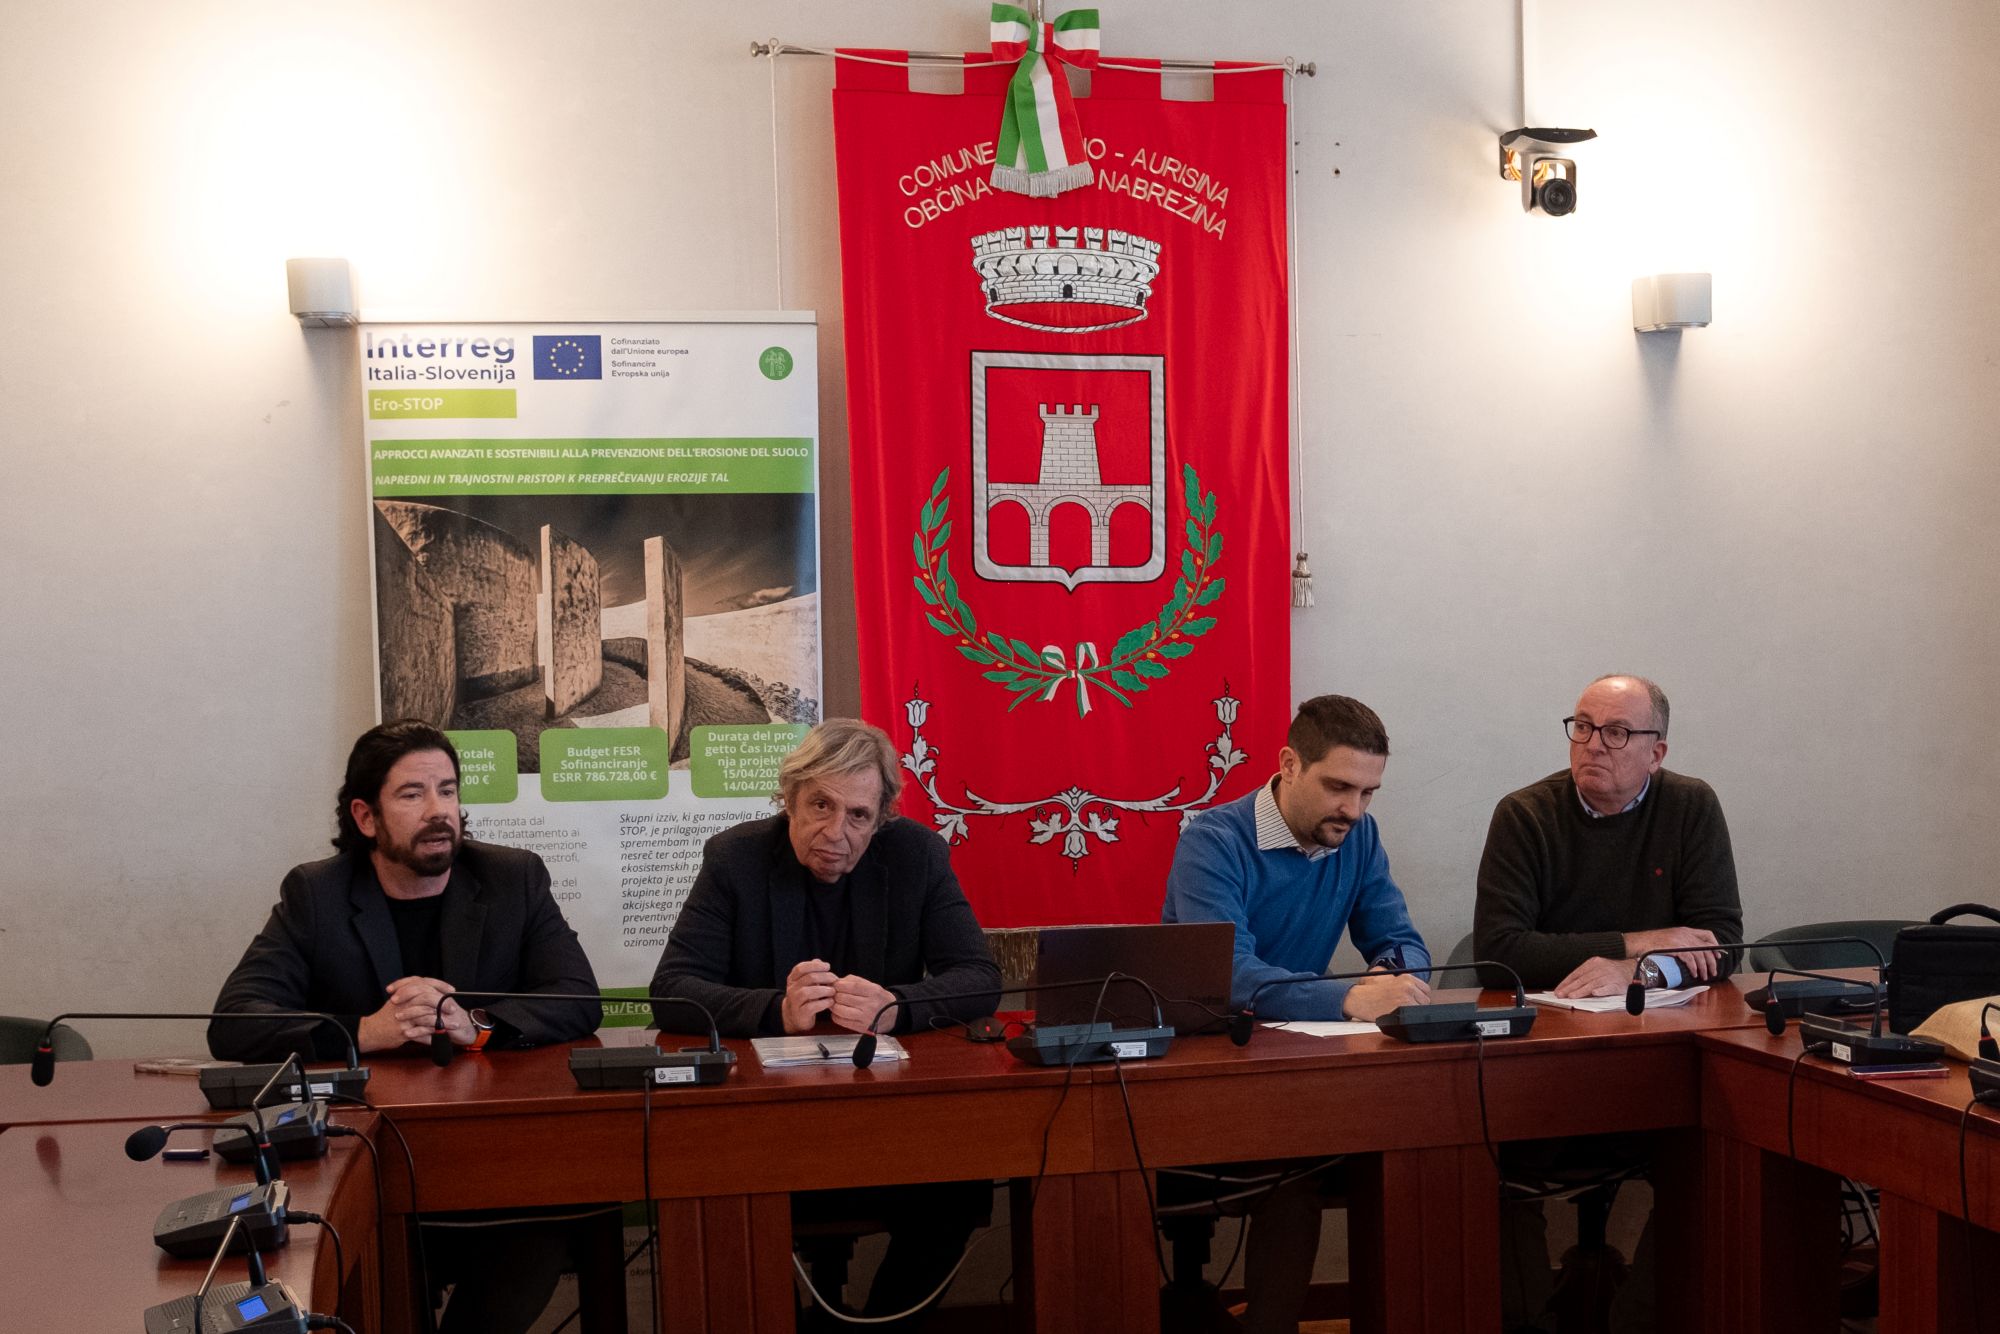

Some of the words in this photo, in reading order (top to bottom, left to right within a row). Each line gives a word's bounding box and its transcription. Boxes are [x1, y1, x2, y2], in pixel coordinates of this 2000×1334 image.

[899, 142, 996, 196] COMUNE
[1131, 148, 1229, 209] AURISINA
[904, 176, 993, 228] OBČINA
[1098, 169, 1227, 240] NABREŽINA
[366, 332, 514, 363] Interreg
[610, 338, 660, 346] Cofinanziato
[611, 347, 655, 355] dall'Unione
[612, 360, 656, 368] Sofinancira
[369, 365, 515, 383] Italia-Slovenija
[612, 370, 648, 378] Evropska
[651, 370, 670, 378] unija
[374, 398, 444, 411] Ero-STOP
[374, 450, 428, 460] APPROCCI
[430, 450, 484, 459] AVANZATI
[487, 449, 492, 458] E
[495, 449, 559, 458] SOSTENIBILI
[562, 448, 589, 458] ALLA
[592, 448, 664, 458] PREVENZIONE
[667, 448, 748, 458] DELL'EROSIONE
[750, 448, 770, 457] DEL
[772, 448, 808, 457] SUOLO
[375, 475, 430, 485] NAPREDNI
[433, 475, 446, 484] IN
[449, 474, 514, 486] TRAJNOSTNI
[517, 474, 565, 484] PRISTOPI
[568, 474, 576, 483] K
[578, 472, 664, 485] PREPREČEVANJU
[667, 473, 708, 485] EROZIJE
[710, 473, 729, 483] TAL
[708, 732, 750, 742] Durata
[753, 731, 770, 740] del
[774, 732, 798, 743] pro-
[568, 747, 609, 759] Budget
[613, 746, 640, 756] FESR
[705, 744, 736, 757] getto
[740, 742, 760, 754] Čas
[764, 742, 797, 754] izvaja
[460, 760, 496, 772] nesek
[560, 758, 648, 771] Sofinanciranje
[718, 757, 736, 769] nja
[740, 756, 782, 768] projekt
[553, 772, 582, 782] ESRR
[586, 772, 647, 783] 786.728,00
[650, 771, 657, 780] €
[723, 768, 780, 779] 15/04/202
[462, 775, 480, 787] ,00
[482, 774, 490, 784] €
[723, 780, 780, 791] 14/04/202
[477, 817, 526, 827] affrontata
[530, 816, 544, 826] dal
[620, 813, 652, 824] Skupni
[656, 813, 678, 823] izziv,
[682, 812, 690, 822] ki
[693, 814, 706, 824] ga
[708, 811, 752, 822] naslavlja
[498, 829, 568, 839] l'adattamento
[571, 829, 580, 838] ai
[620, 826, 648, 836] STOP,
[650, 826, 660, 837] je
[662, 824, 722, 836] prilagajanje
[524, 841, 588, 850] prevenzione
[620, 838, 689, 848] spremembam
[692, 836, 701, 846] in
[542, 852, 580, 863] tastrofi,
[621, 850, 652, 860] nesreč
[656, 851, 669, 860] ter
[672, 849, 703, 861] odpor
[622, 862, 690, 873] ekosistemskih
[562, 878, 578, 888] del
[664, 875, 674, 886] je
[622, 888, 660, 899] skupine
[663, 888, 672, 896] in
[622, 900, 672, 912] akcijskega
[623, 912, 678, 925] preventivni
[624, 927, 636, 936] na
[624, 937, 664, 947] oziroma
[602, 1002, 652, 1014] eu/Ero
